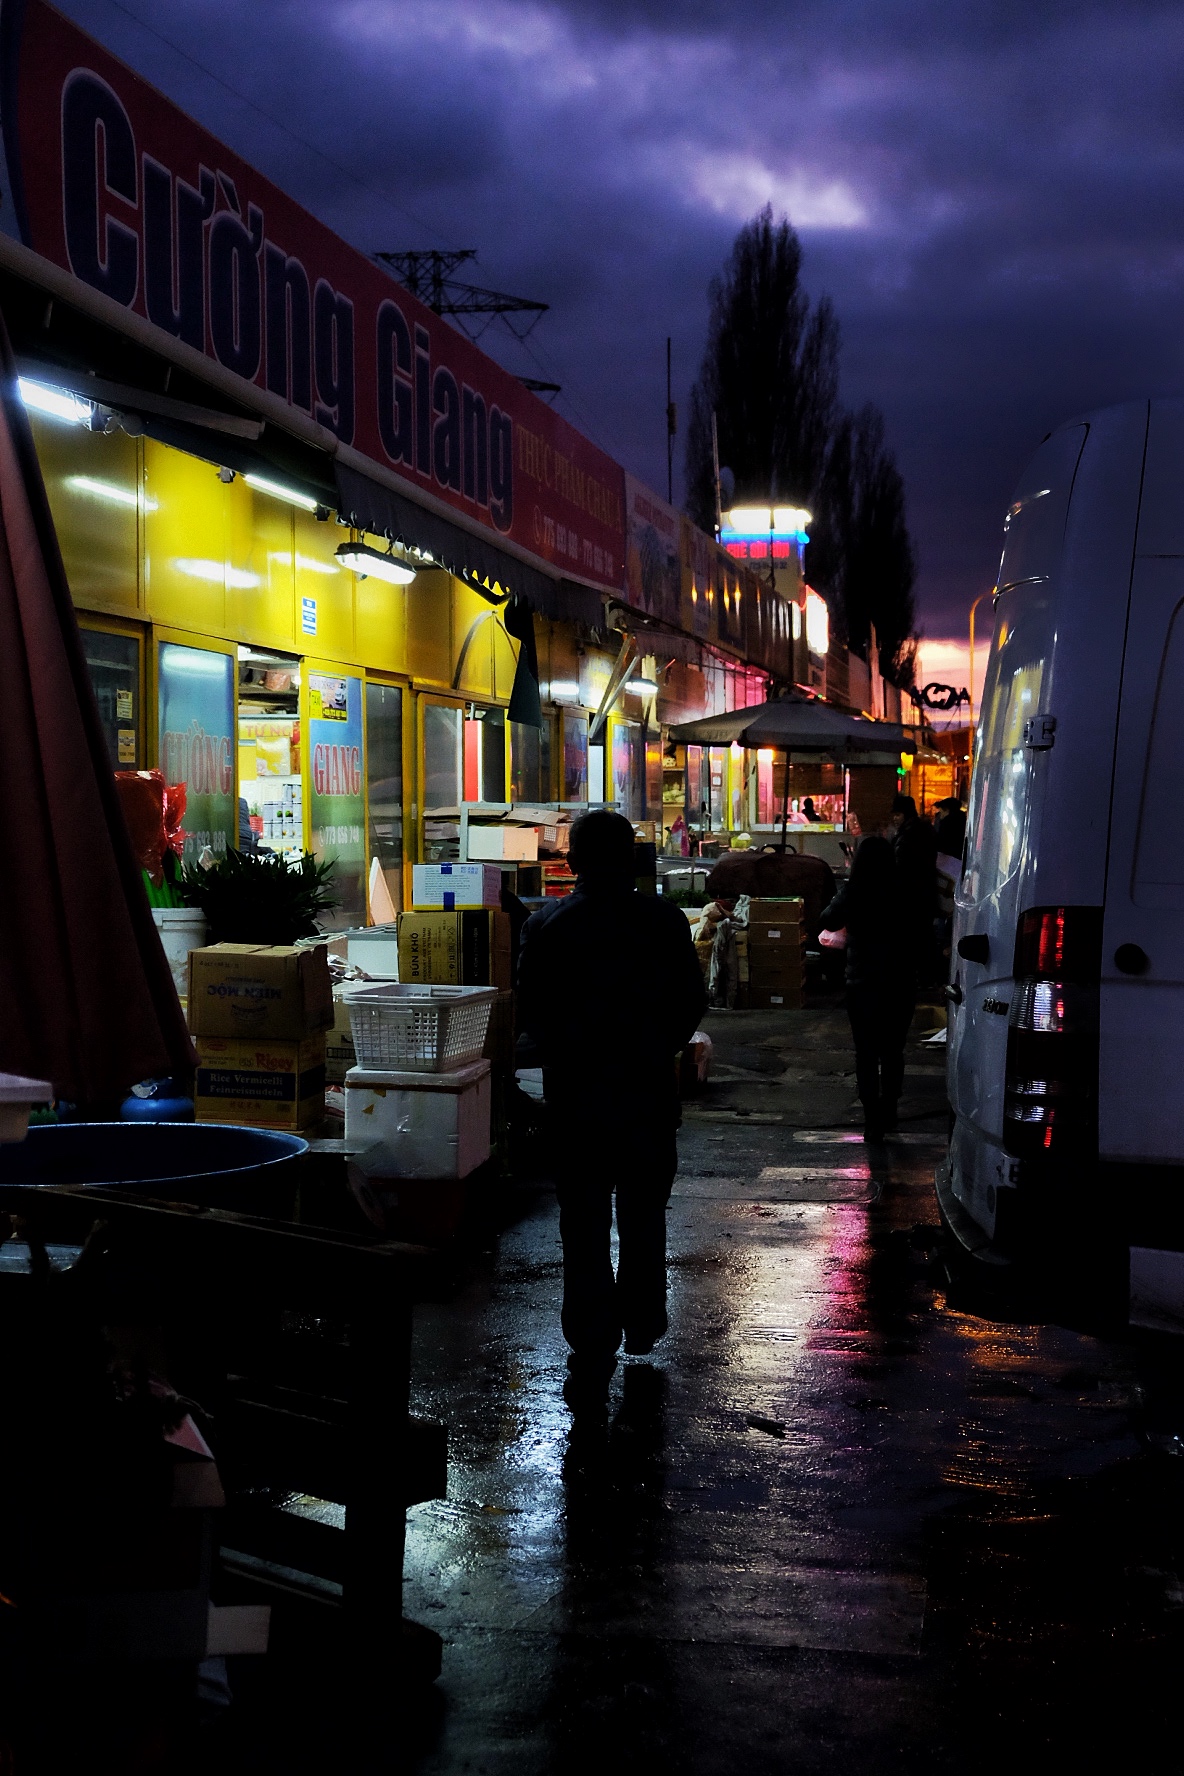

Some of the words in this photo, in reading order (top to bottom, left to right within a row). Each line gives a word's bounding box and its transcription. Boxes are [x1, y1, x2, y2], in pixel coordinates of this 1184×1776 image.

[61, 66, 354, 449] Cường
[376, 299, 513, 536] Giang
[161, 719, 231, 796] CƯỜNG
[313, 743, 361, 796] GIANG
[213, 830, 226, 852] 888
[325, 826, 336, 845] 773
[409, 955, 419, 977] BÚN
[207, 982, 239, 999] MỘC
[209, 1073, 230, 1083] Rice
[234, 1074, 283, 1086] Vermicelli
[209, 1085, 283, 1097] Feinreisnudeln
